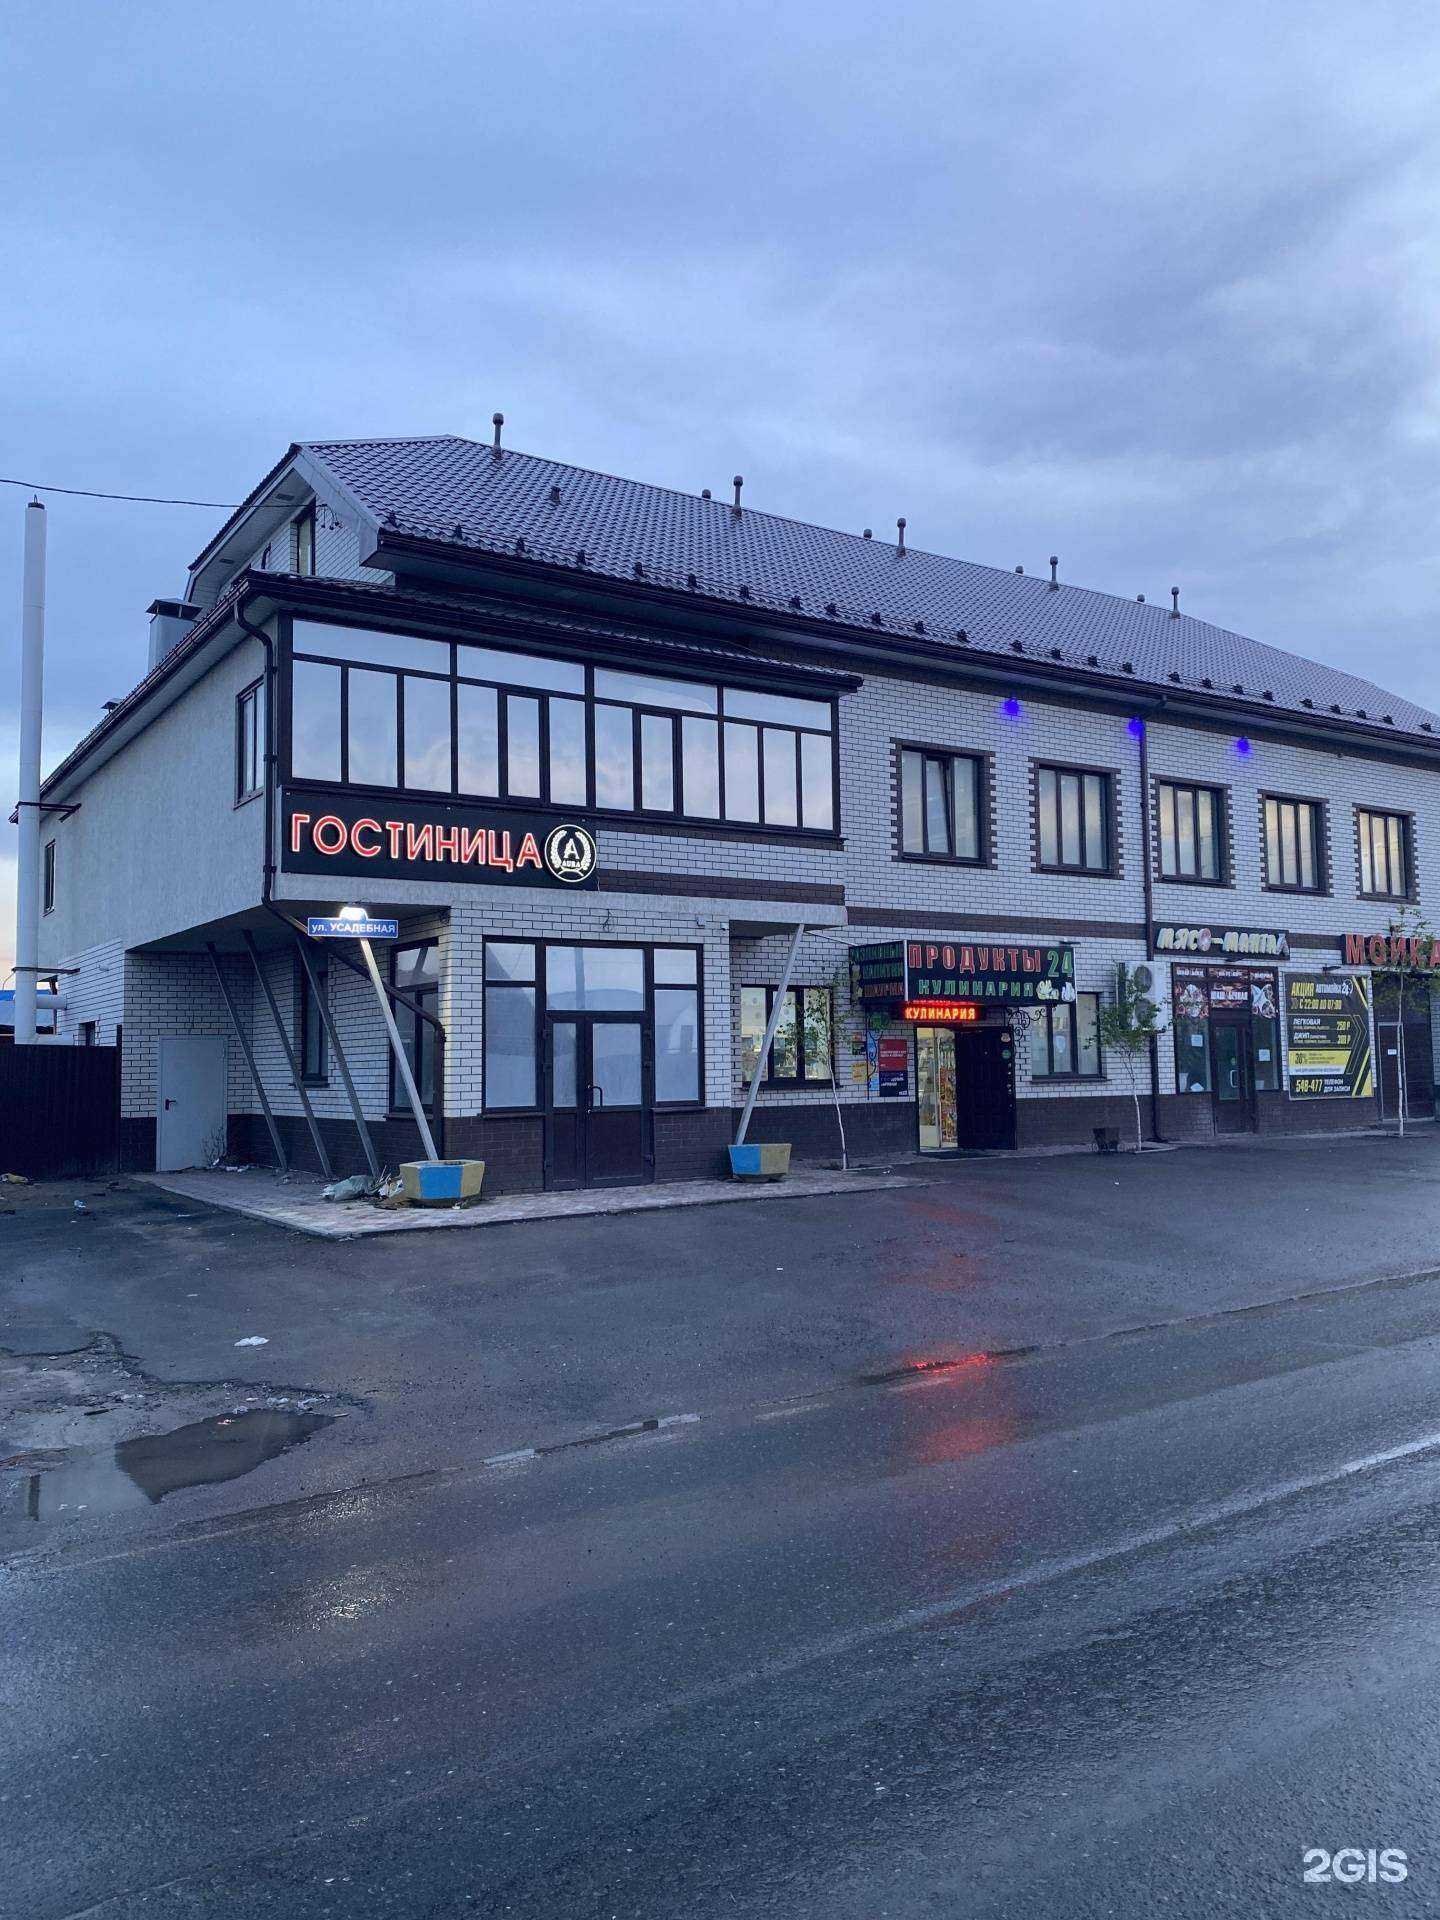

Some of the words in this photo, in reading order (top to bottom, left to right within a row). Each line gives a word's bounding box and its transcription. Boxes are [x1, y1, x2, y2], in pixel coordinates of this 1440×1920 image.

[291, 813, 544, 873] ГОСТИНИЦА
[311, 923, 327, 934] ул.
[330, 921, 396, 935] УСАДЕБНАЯ
[908, 944, 1041, 974] ПРОДУКТЫ
[1047, 950, 1074, 978] 24
[918, 979, 1034, 997] КУЛИНАРИЯ
[1291, 981, 1315, 998] АКЦИЯ
[905, 1006, 976, 1021] КУЛИНАРИЯ
[1293, 1018, 1321, 1026] ЛЕГКОВАЯ
[1295, 1079, 1323, 1093] 548-477
